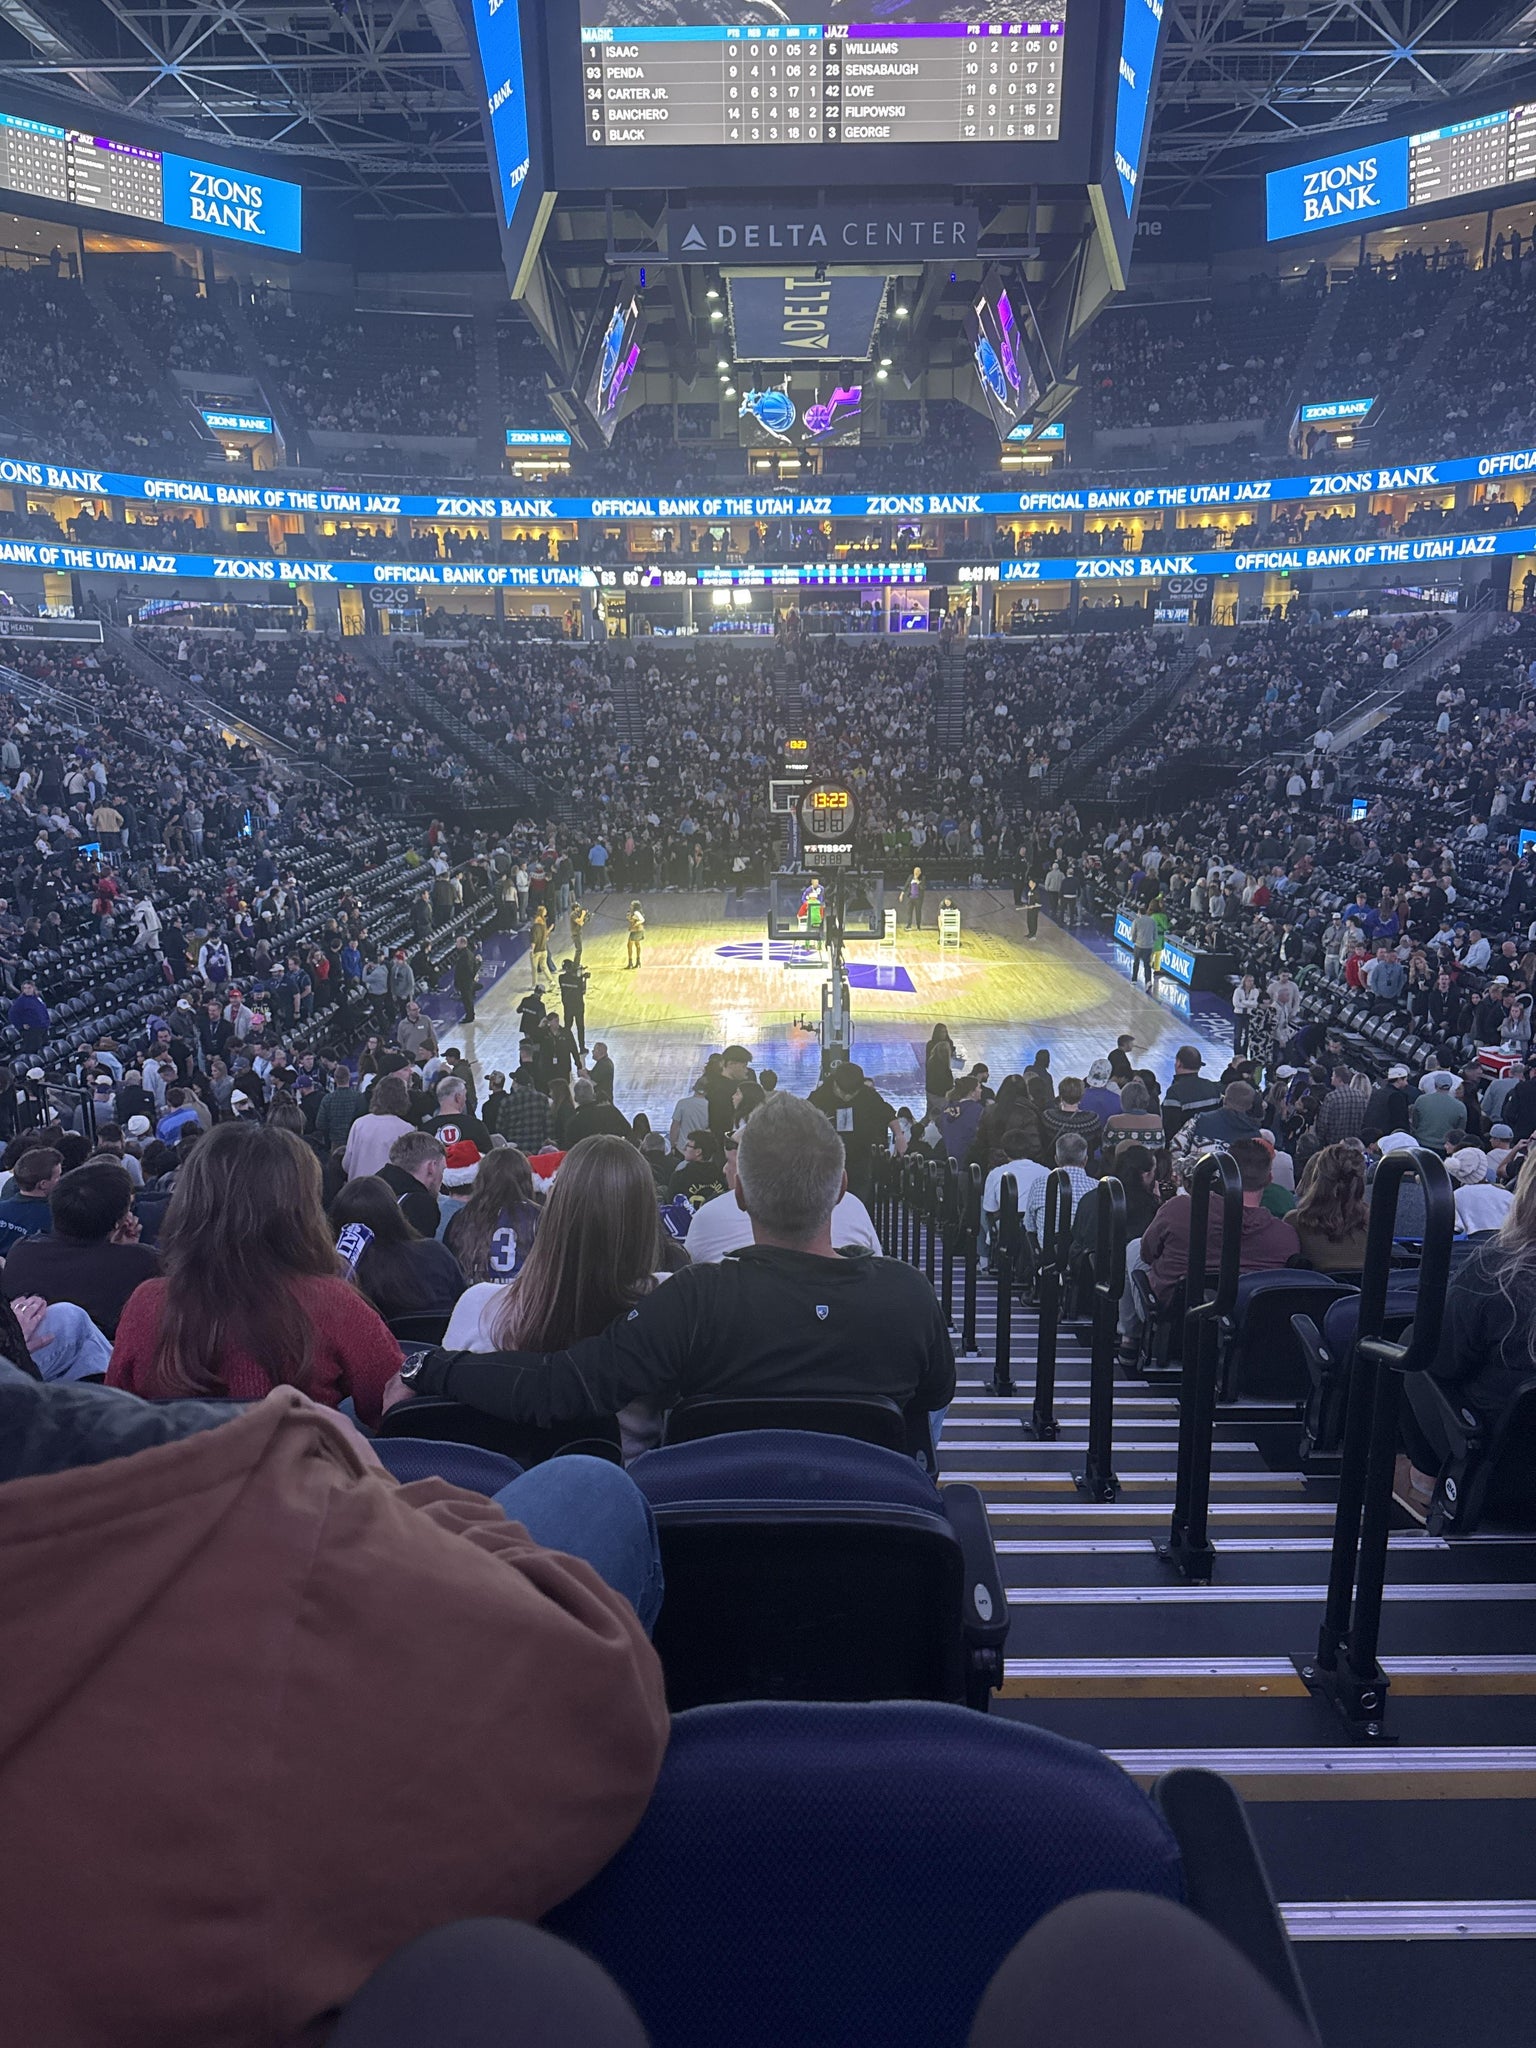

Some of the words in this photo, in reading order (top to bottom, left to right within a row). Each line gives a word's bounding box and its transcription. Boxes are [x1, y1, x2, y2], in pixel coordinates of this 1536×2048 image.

[582, 29, 614, 41] MAGIC
[824, 25, 848, 38] JAZZ
[590, 47, 596, 57] 1
[606, 46, 638, 57] ISAAC
[730, 46, 736, 56] 0
[751, 45, 758, 56] 0
[770, 45, 777, 55] 0
[787, 45, 800, 55] 05
[810, 44, 816, 55] 2
[829, 44, 837, 54] 5
[846, 43, 899, 54] WILLIAMS
[969, 42, 976, 52] 0
[991, 42, 998, 52] 2
[1011, 41, 1018, 52] 2
[1026, 41, 1040, 52] 05
[1050, 41, 1057, 51] 0
[587, 68, 601, 79] 93
[607, 67, 644, 79] PENDA
[730, 66, 737, 77] 9
[751, 66, 758, 76] 4
[771, 66, 775, 76] 1
[787, 66, 800, 76] 06
[810, 65, 816, 76] 2
[826, 64, 839, 76] 28
[845, 64, 918, 75] SENSABAUGH
[967, 63, 977, 74] 10
[991, 63, 997, 73] 3
[1010, 63, 1017, 73] 0
[1027, 63, 1037, 72] 17
[1050, 62, 1054, 72] 1
[588, 89, 602, 100] 34
[608, 89, 650, 100] CARTER
[652, 89, 668, 100] JR.
[730, 87, 737, 98] 6
[751, 87, 758, 97] 6
[770, 87, 777, 97] 3
[789, 87, 799, 97] 17
[811, 87, 815, 96] 1
[826, 86, 839, 96] 42
[845, 85, 874, 96] LOVE
[967, 85, 975, 94] 11
[990, 84, 996, 94] 6
[1009, 84, 1016, 94] 0
[1026, 83, 1036, 94] 13
[1048, 83, 1054, 93] 2
[592, 109, 599, 121] 5
[609, 109, 668, 120] BANCHERO
[729, 108, 739, 118] 14
[752, 108, 758, 118] 5
[770, 108, 777, 118] 4
[788, 108, 799, 118] 18
[810, 107, 816, 117] 2
[826, 107, 839, 117] 22
[845, 106, 905, 117] FILIPOWSKI
[968, 105, 974, 115] 5
[989, 105, 995, 115] 3
[1009, 105, 1013, 114] 1
[1025, 104, 1035, 114] 15
[1047, 104, 1053, 114] 2
[592, 130, 600, 141] 0
[610, 130, 645, 141] BLACK
[731, 129, 738, 138] 4
[752, 128, 758, 139] 3
[770, 128, 777, 138] 3
[788, 128, 799, 138] 18
[809, 128, 816, 137] 0
[829, 127, 836, 138] 3
[845, 127, 890, 138] GEORGE
[965, 126, 975, 136] 12
[989, 126, 993, 135] 1
[1007, 125, 1014, 135] 5
[1024, 125, 1034, 135] 18
[1047, 125, 1051, 134] 1
[1302, 157, 1377, 197] ZIONS
[189, 170, 263, 208] ZIONS
[717, 224, 827, 248] DELTA
[842, 221, 967, 246] CENTER
[1306, 405, 1337, 418] ZIONS
[207, 415, 237, 428] ZIONS
[510, 433, 537, 443] ZIONS
[1309, 473, 1372, 496] ZIONS
[144, 479, 213, 502] OFFICIAL
[217, 488, 259, 506] BANK
[264, 490, 284, 507] OF
[287, 492, 318, 509] THE
[322, 495, 361, 512] UTAH
[364, 496, 401, 513] JAZZ
[1020, 493, 1083, 510] OFFICIAL
[1088, 492, 1131, 508] BANK
[1134, 490, 1154, 505] OF
[1157, 488, 1187, 503] THE
[1190, 486, 1230, 502] UTAH
[1234, 483, 1271, 500] JAZZ
[436, 498, 496, 516] ZIONS
[592, 500, 655, 516] OFFICIAL
[659, 499, 699, 515] BANK
[703, 499, 722, 515] OF
[725, 499, 752, 514] THE
[756, 498, 793, 514] UTAH
[797, 498, 832, 514] JAZZ
[867, 497, 924, 514] ZIONS
[40, 547, 59, 564] OF
[61, 550, 93, 568] THE
[96, 552, 136, 570] UTAH
[139, 556, 177, 573] JAZZ
[1235, 550, 1302, 570] OFFICIAL
[1306, 549, 1350, 568] BANK
[1355, 547, 1375, 563] OF
[1379, 544, 1410, 561] THE
[1413, 540, 1454, 559] UTAH
[1457, 536, 1496, 555] JAZZ
[213, 559, 274, 579] ZIONS
[374, 566, 440, 583] OFFICIAL
[447, 568, 486, 584] BANK
[488, 568, 507, 584] OF
[510, 568, 539, 584] THE
[542, 568, 579, 584] UTAH
[1005, 562, 1040, 578] JAZZ
[1076, 560, 1134, 578] ZIONS
[1168, 577, 1208, 593] G2G
[369, 587, 408, 603] G2G
[11, 624, 33, 632] HEALTH
[814, 792, 848, 808] 13:23
[443, 1128, 456, 1142] U
[489, 1226, 517, 1272] 3
